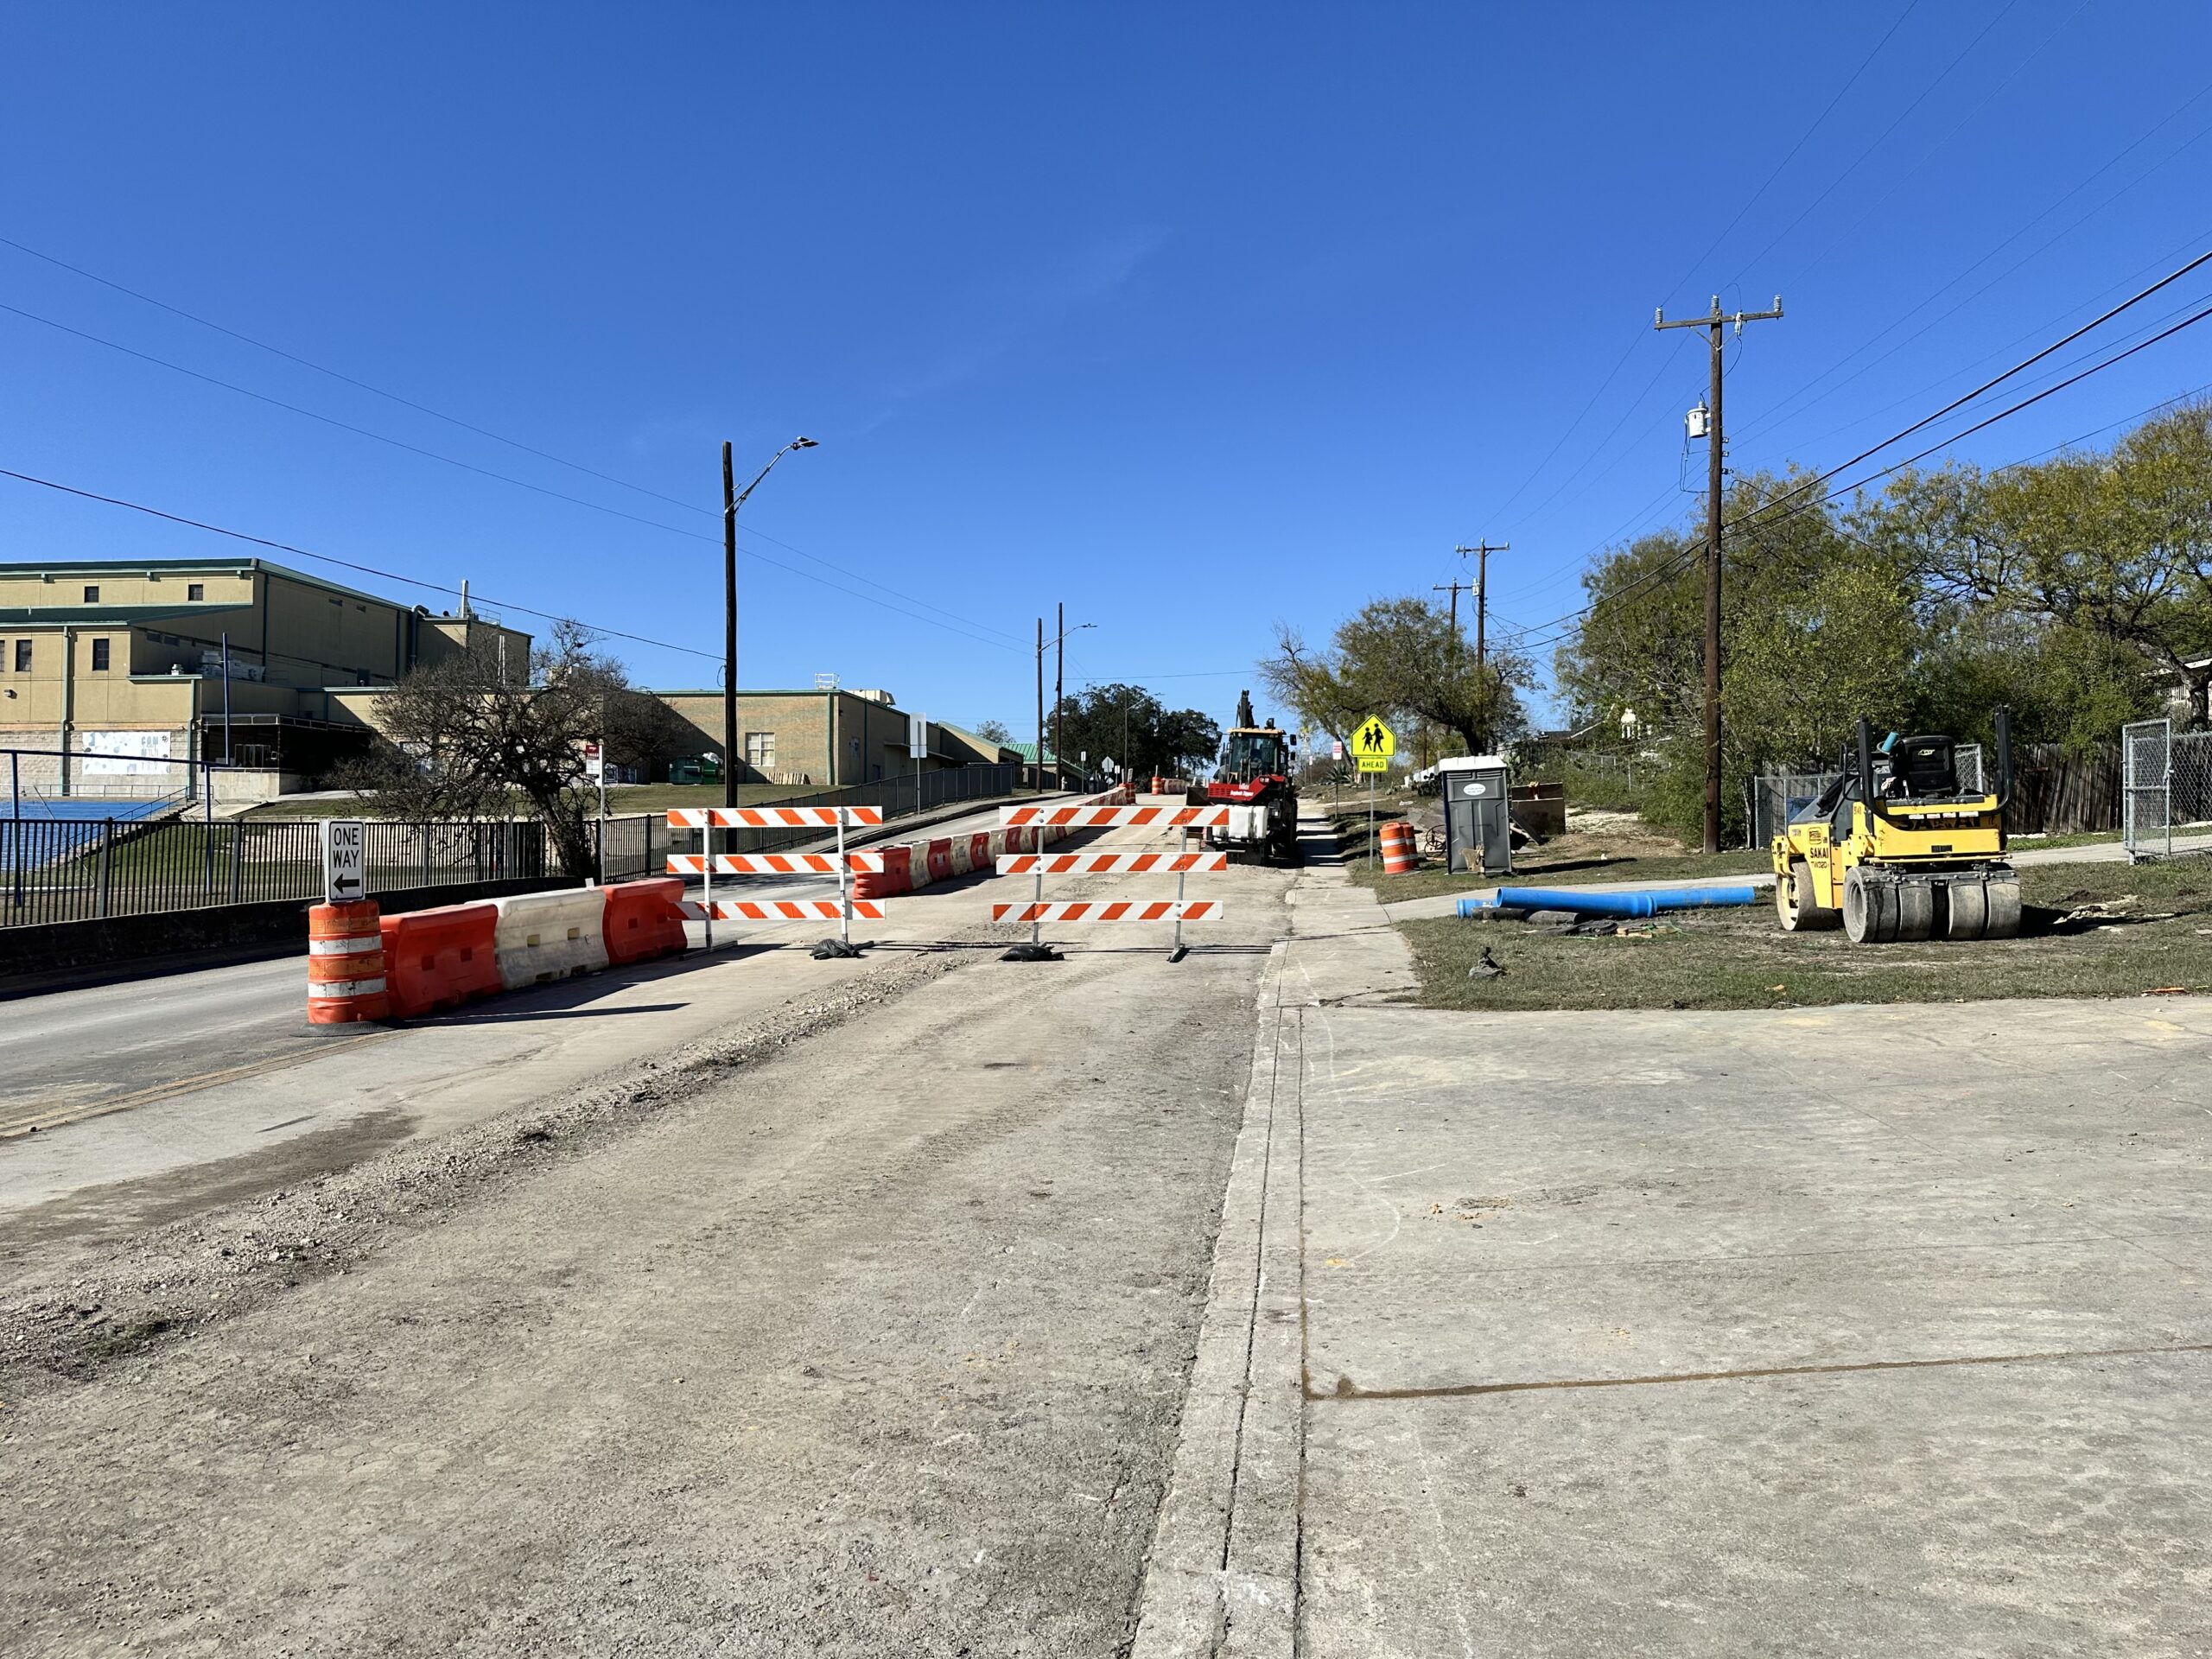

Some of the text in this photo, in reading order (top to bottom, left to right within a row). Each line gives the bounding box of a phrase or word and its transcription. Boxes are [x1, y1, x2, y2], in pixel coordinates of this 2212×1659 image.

[1361, 760, 1384, 769] AHEAD
[334, 827, 359, 846] ONE
[333, 849, 359, 868] WAY
[1809, 847, 1829, 859] SAKAI
